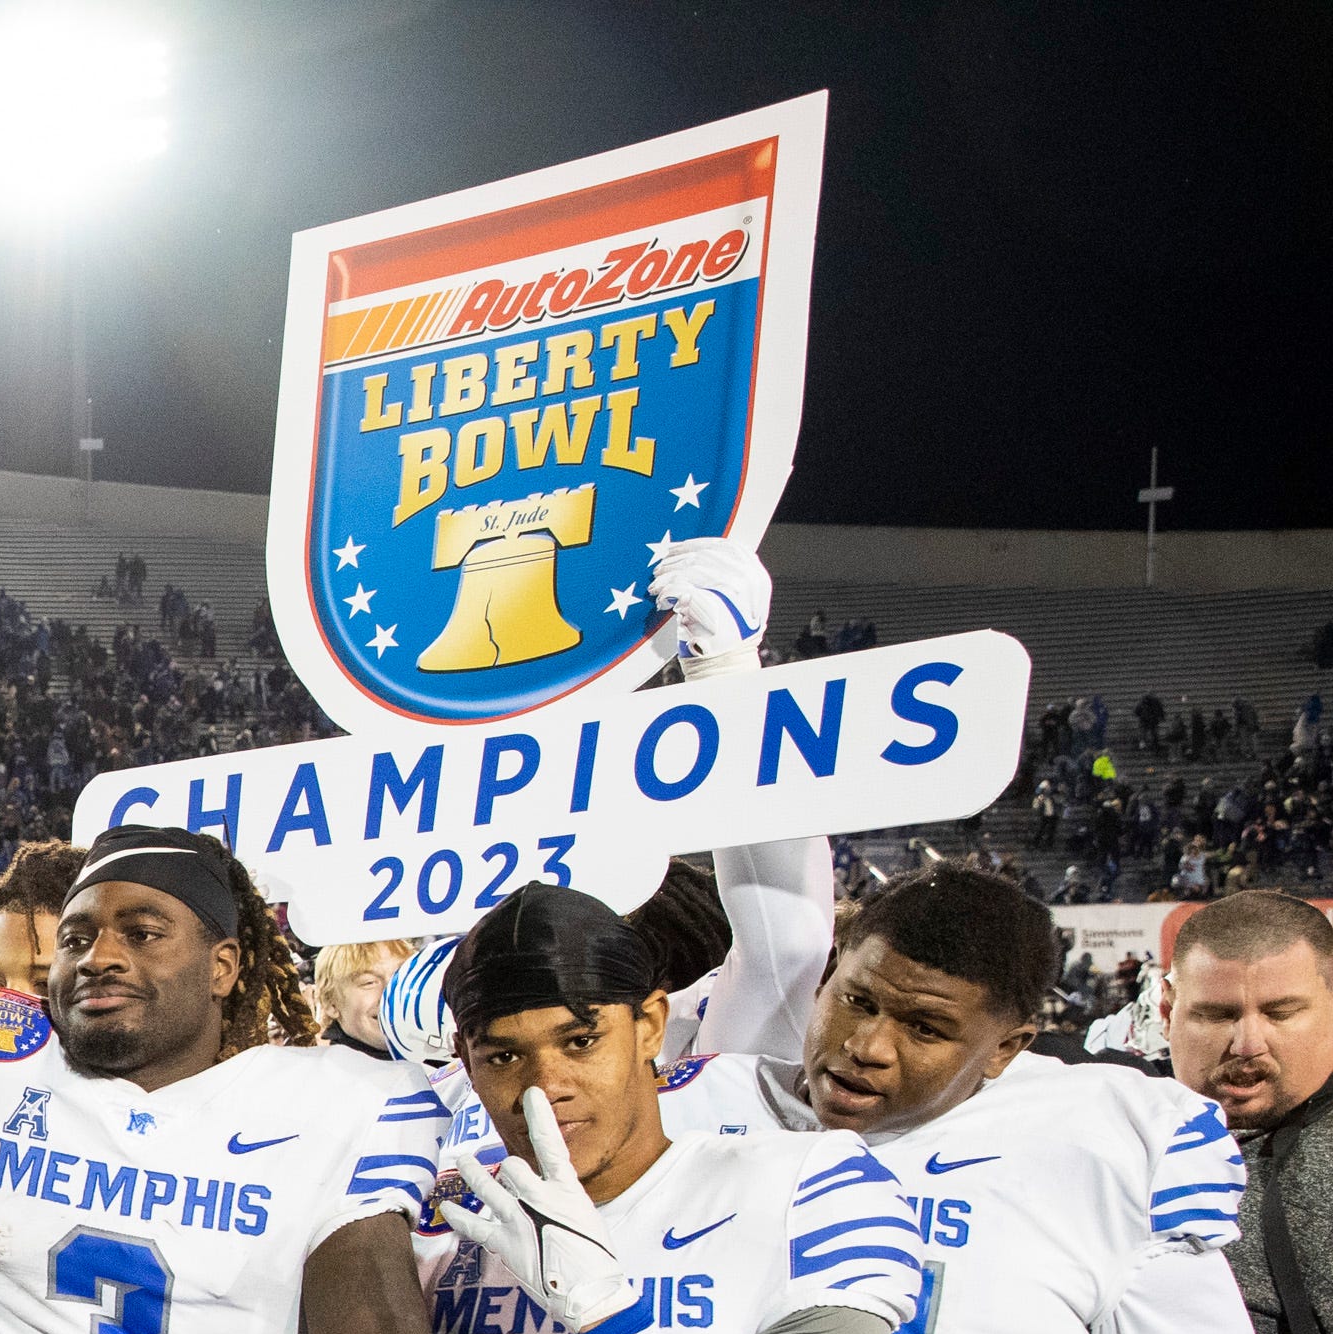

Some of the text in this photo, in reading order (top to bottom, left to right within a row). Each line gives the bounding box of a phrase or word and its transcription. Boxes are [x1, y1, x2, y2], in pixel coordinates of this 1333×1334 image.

[447, 228, 748, 336] AutoZone
[360, 300, 715, 432] LIBERTY
[393, 388, 656, 529] BOWL
[479, 506, 549, 533] St. Jude
[107, 662, 964, 854] CHAMPIONS
[363, 833, 577, 922] 2023
[1081, 929, 1144, 938] Simmons
